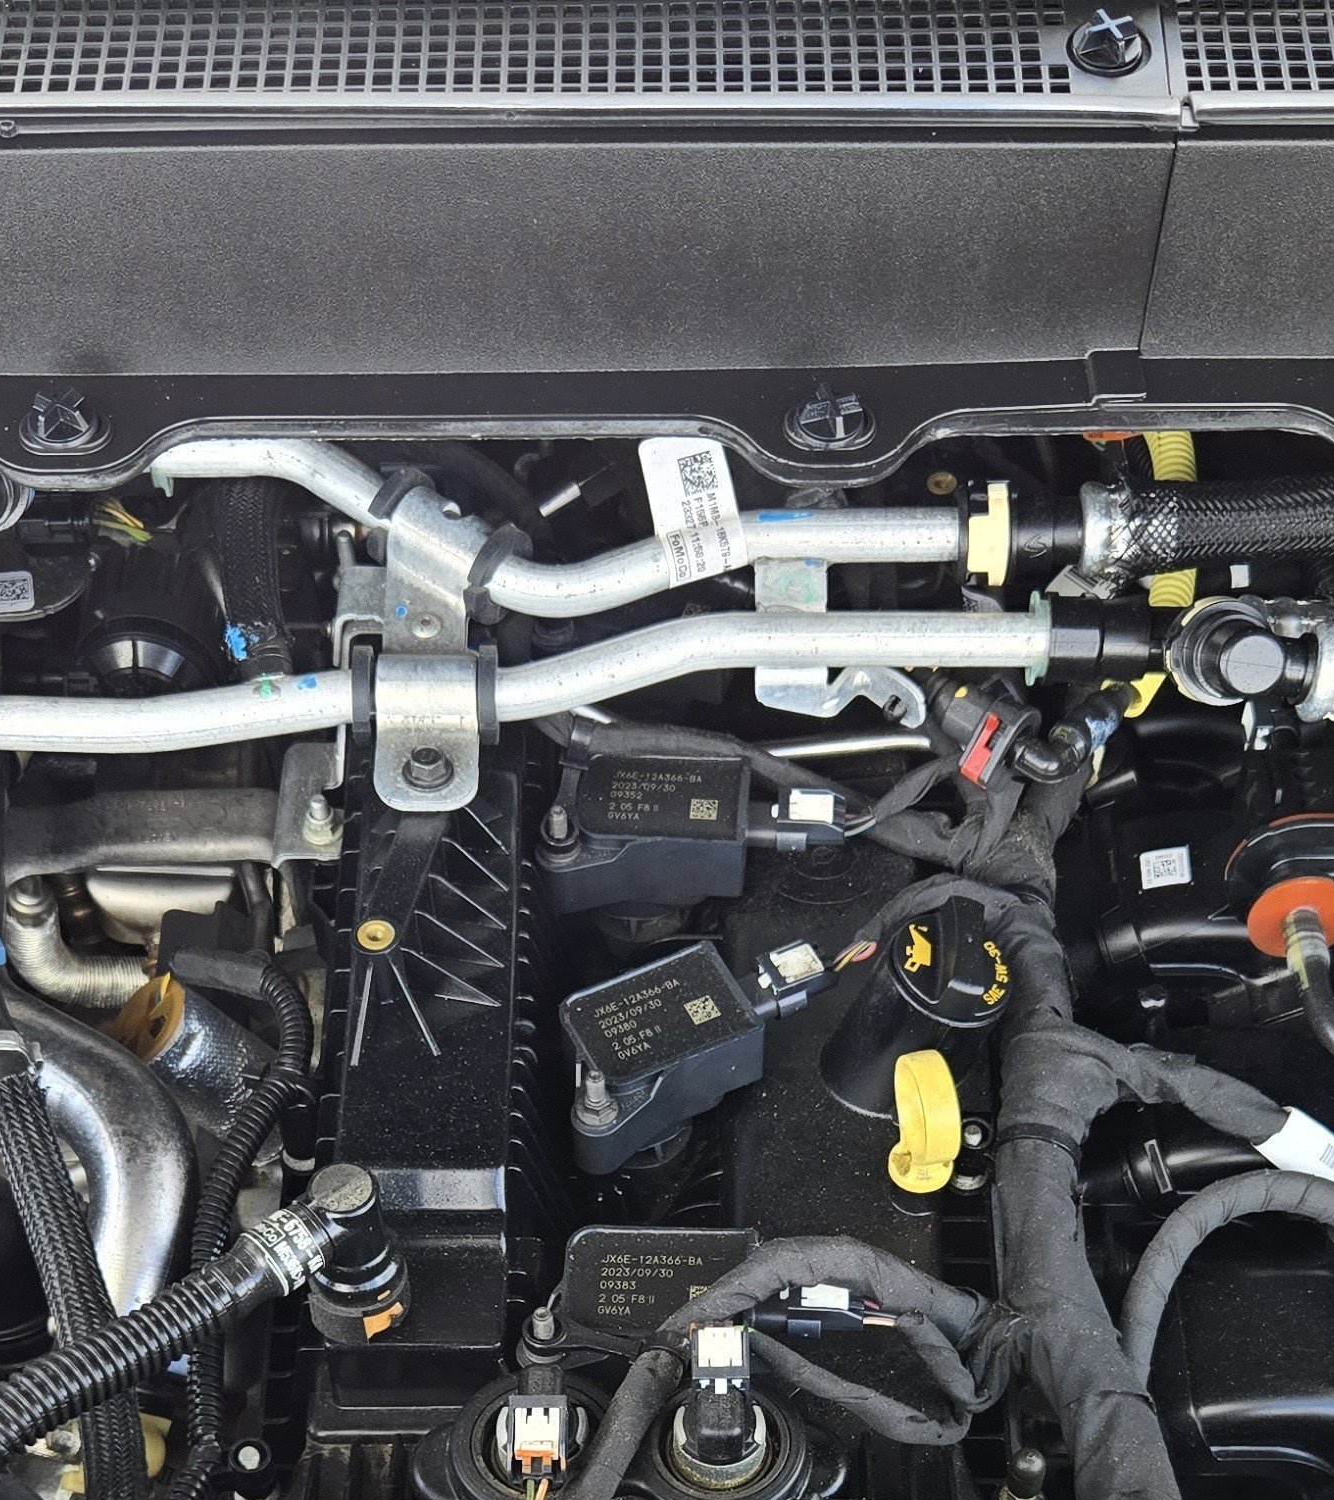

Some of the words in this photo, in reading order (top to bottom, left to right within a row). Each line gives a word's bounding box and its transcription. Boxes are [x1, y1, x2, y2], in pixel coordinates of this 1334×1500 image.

[669, 533, 687, 578] FoMoCo
[611, 782, 676, 792] 2023/09/30
[610, 791, 643, 800] 09352
[983, 940, 1009, 983] 5W-30
[593, 978, 681, 1018] JX6E-12A366-BA
[982, 983, 1006, 1005] SAE
[598, 998, 662, 1029] 2023/09/30
[604, 1020, 637, 1038] 09380
[611, 1041, 622, 1051] 2
[622, 1036, 637, 1047] 05
[600, 1254, 703, 1266] JX6E-12A366-BA
[600, 1267, 674, 1278] 2023/09/30
[599, 1280, 637, 1290] 09383
[598, 1293, 606, 1303] 2
[611, 1293, 626, 1303] 05
